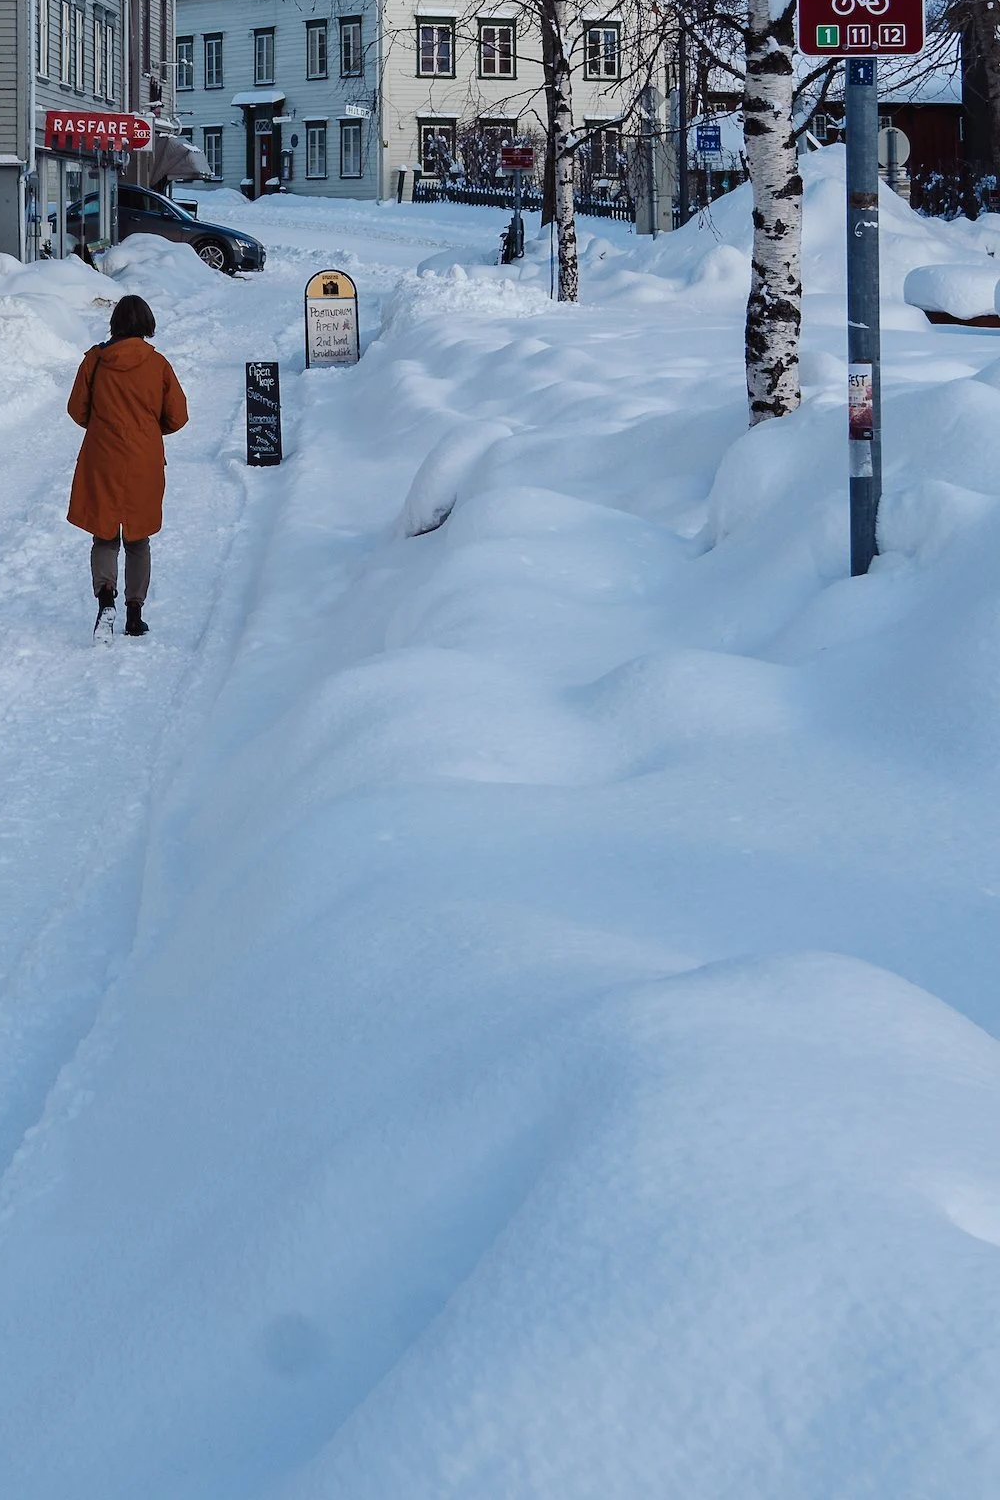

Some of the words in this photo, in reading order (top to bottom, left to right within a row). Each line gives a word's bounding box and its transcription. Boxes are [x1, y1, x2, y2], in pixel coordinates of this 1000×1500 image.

[825, 28, 831, 43] 1
[851, 28, 866, 43] 11
[883, 28, 901, 43] 12
[857, 67, 864, 79] 1
[347, 106, 370, 118] HILDR
[53, 118, 128, 135] RASFARE
